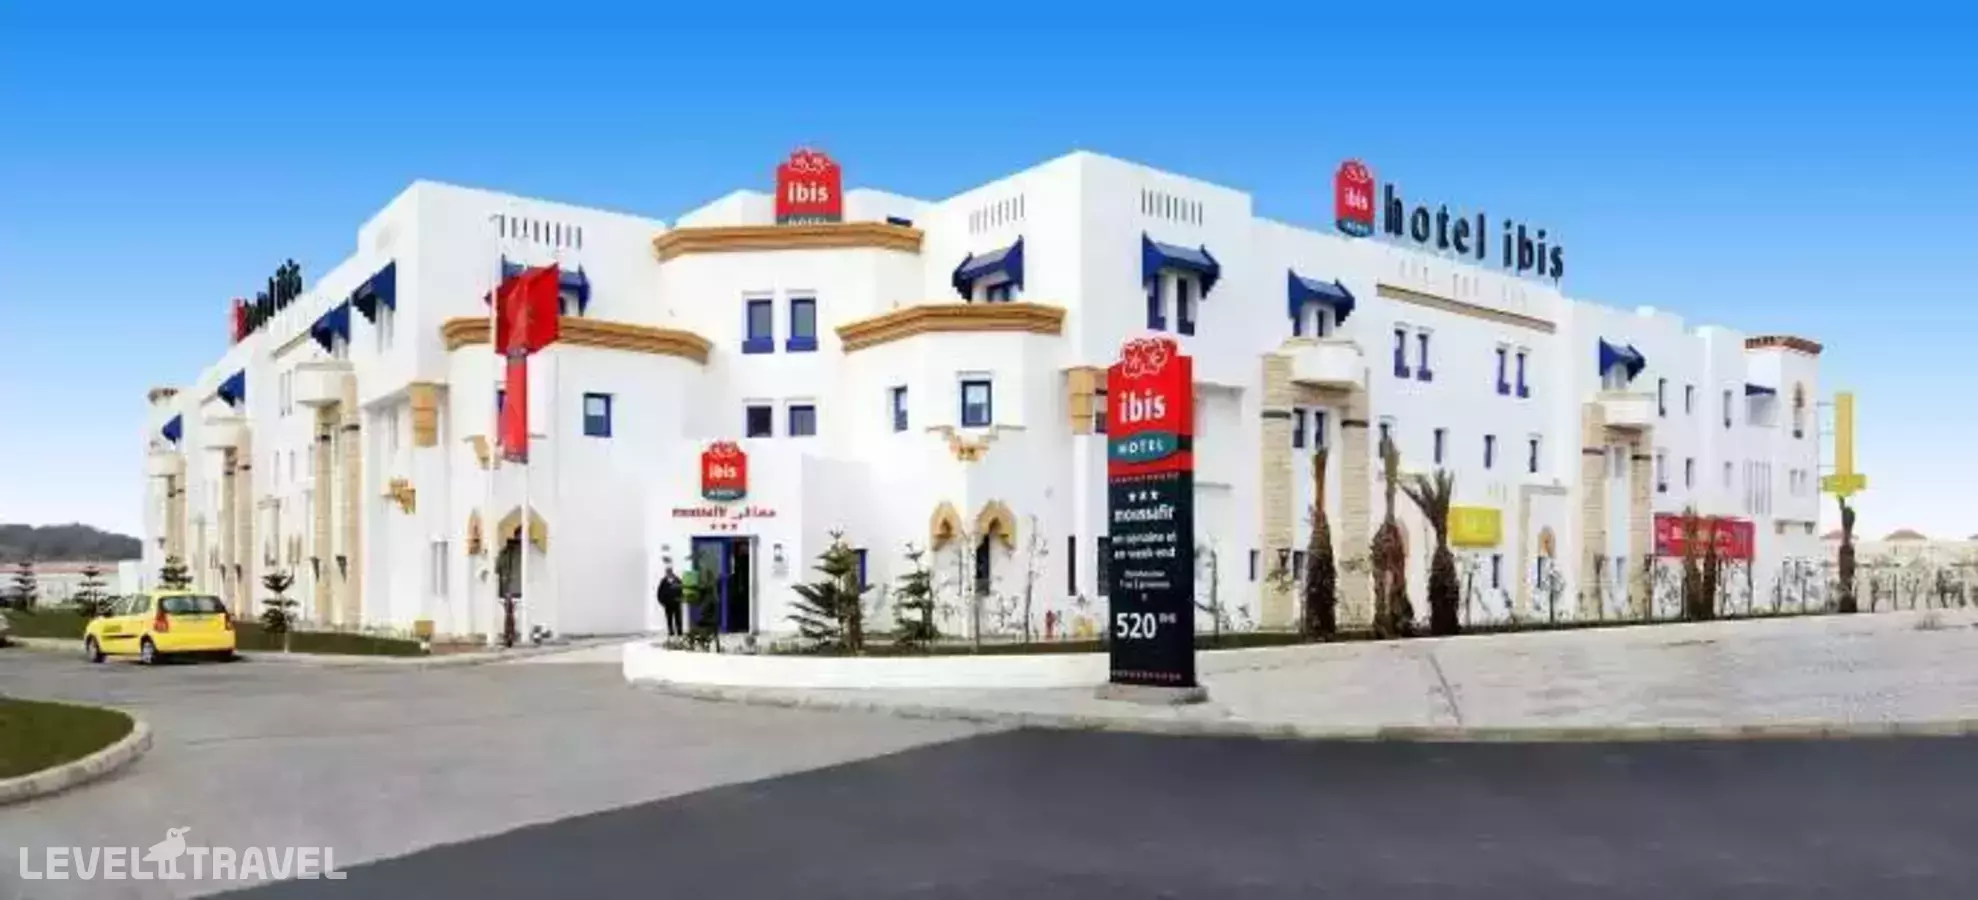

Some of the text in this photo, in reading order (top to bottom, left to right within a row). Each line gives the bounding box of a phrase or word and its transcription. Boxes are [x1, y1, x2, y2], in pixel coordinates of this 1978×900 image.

[788, 181, 829, 204] ibis
[1344, 187, 1369, 210] ibis
[1384, 182, 1564, 279] hotel ibis
[1119, 388, 1167, 423] ibis
[1117, 436, 1164, 454] HOTEL
[708, 462, 737, 479] ibis
[1114, 504, 1174, 522] moussafir
[1116, 612, 1157, 638] 520
